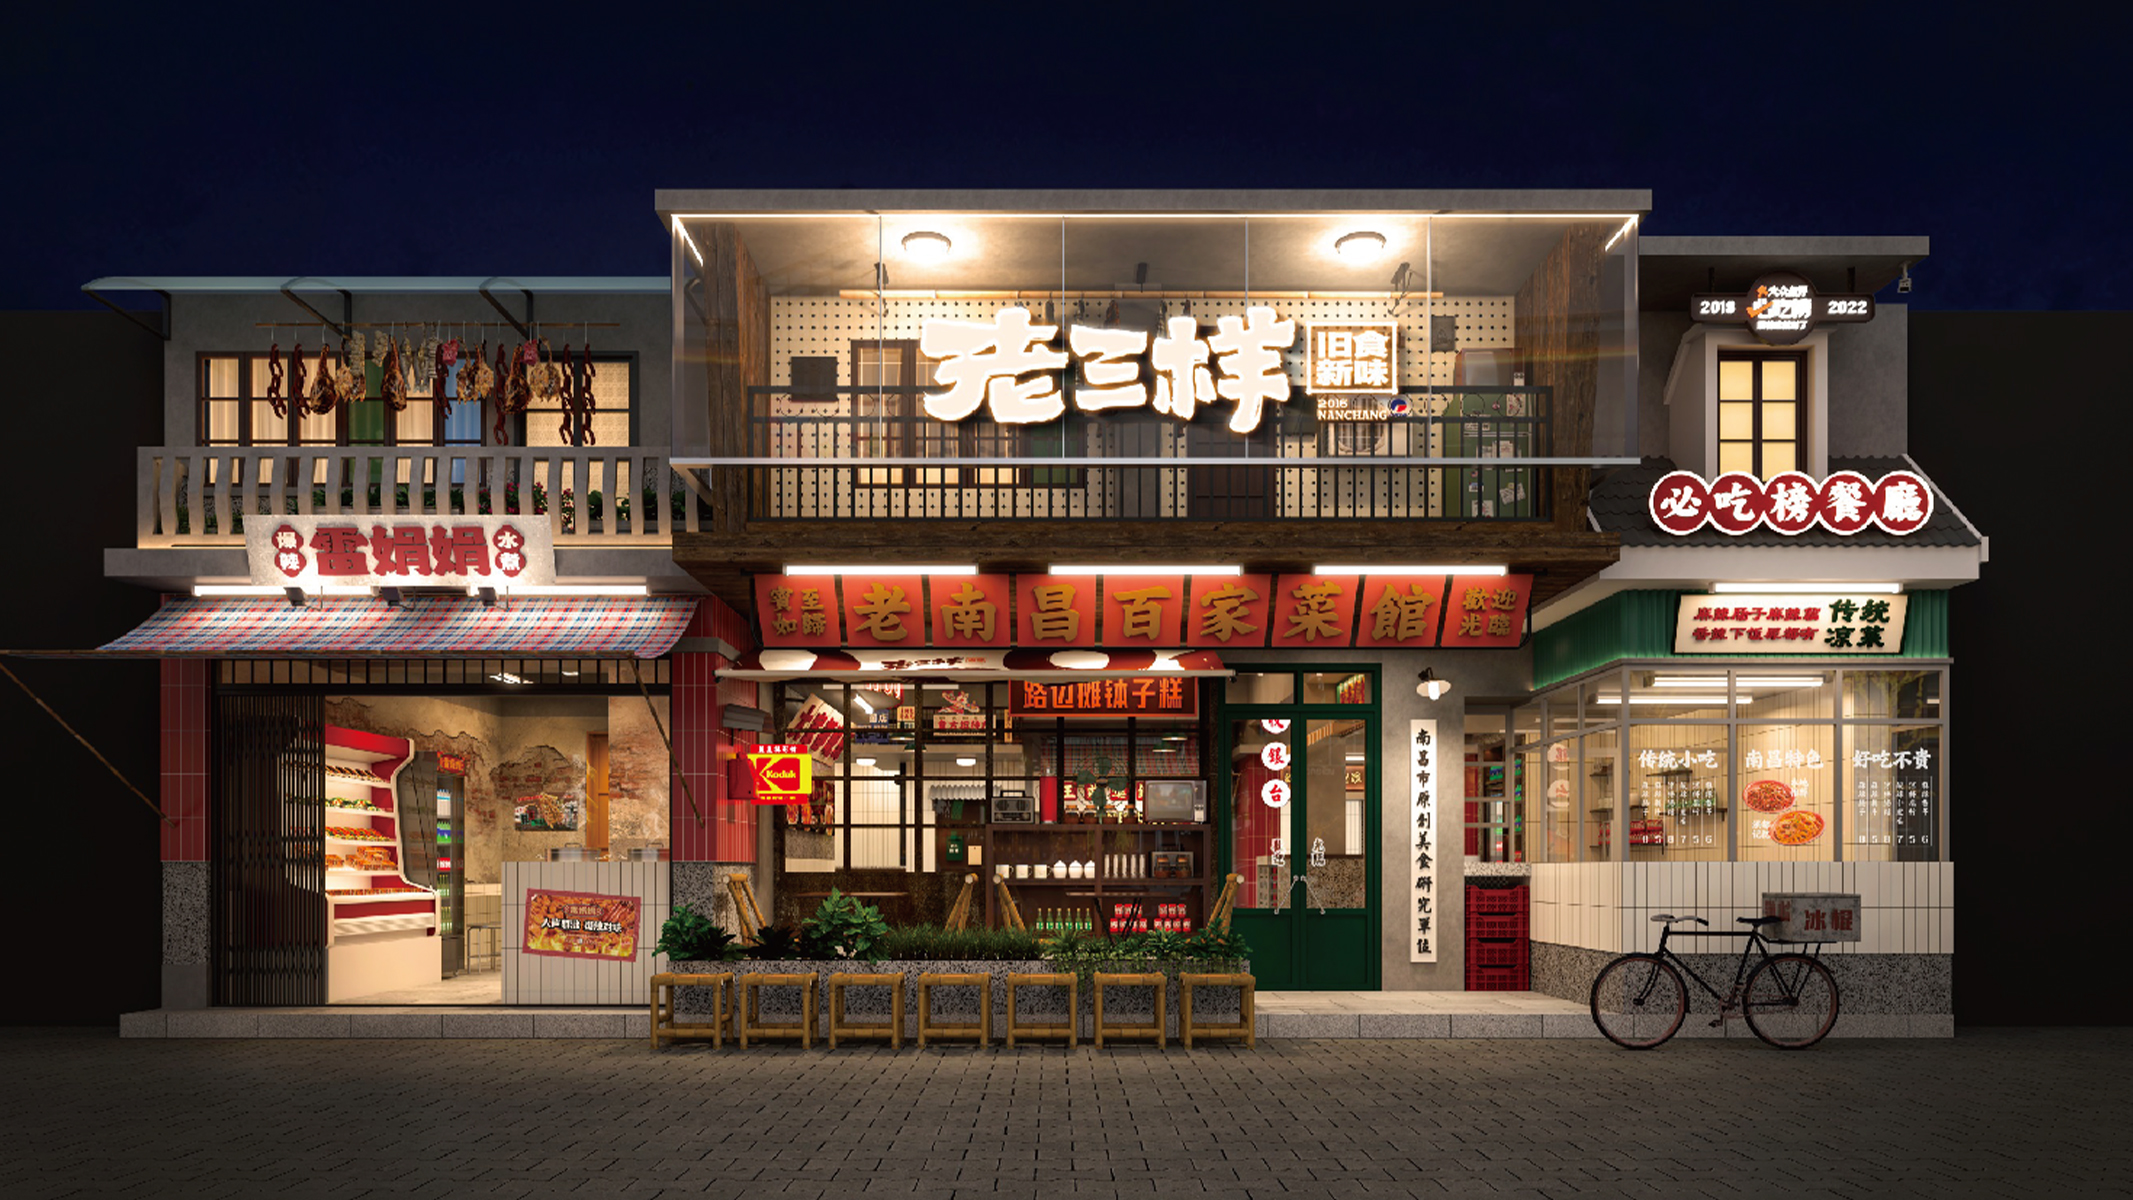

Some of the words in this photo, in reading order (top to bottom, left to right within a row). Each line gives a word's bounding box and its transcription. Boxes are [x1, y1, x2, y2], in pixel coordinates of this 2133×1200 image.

[1828, 300, 1868, 315] 2022
[1317, 330, 1390, 359] 旧食
[920, 306, 1296, 434] 老三样
[1316, 358, 1389, 386] 新味
[1317, 409, 1388, 420] NANCHANG
[852, 580, 1437, 643] 老南昌百家菜館
[1829, 599, 1890, 624] 传统
[1824, 626, 1885, 648] 凉菜
[1638, 749, 1718, 769] 传统小吃
[1745, 748, 1824, 769] 南昌特色
[1852, 748, 1932, 769] 好吃不贵
[766, 770, 796, 779] Kodak
[1804, 909, 1853, 931] 冰棍
